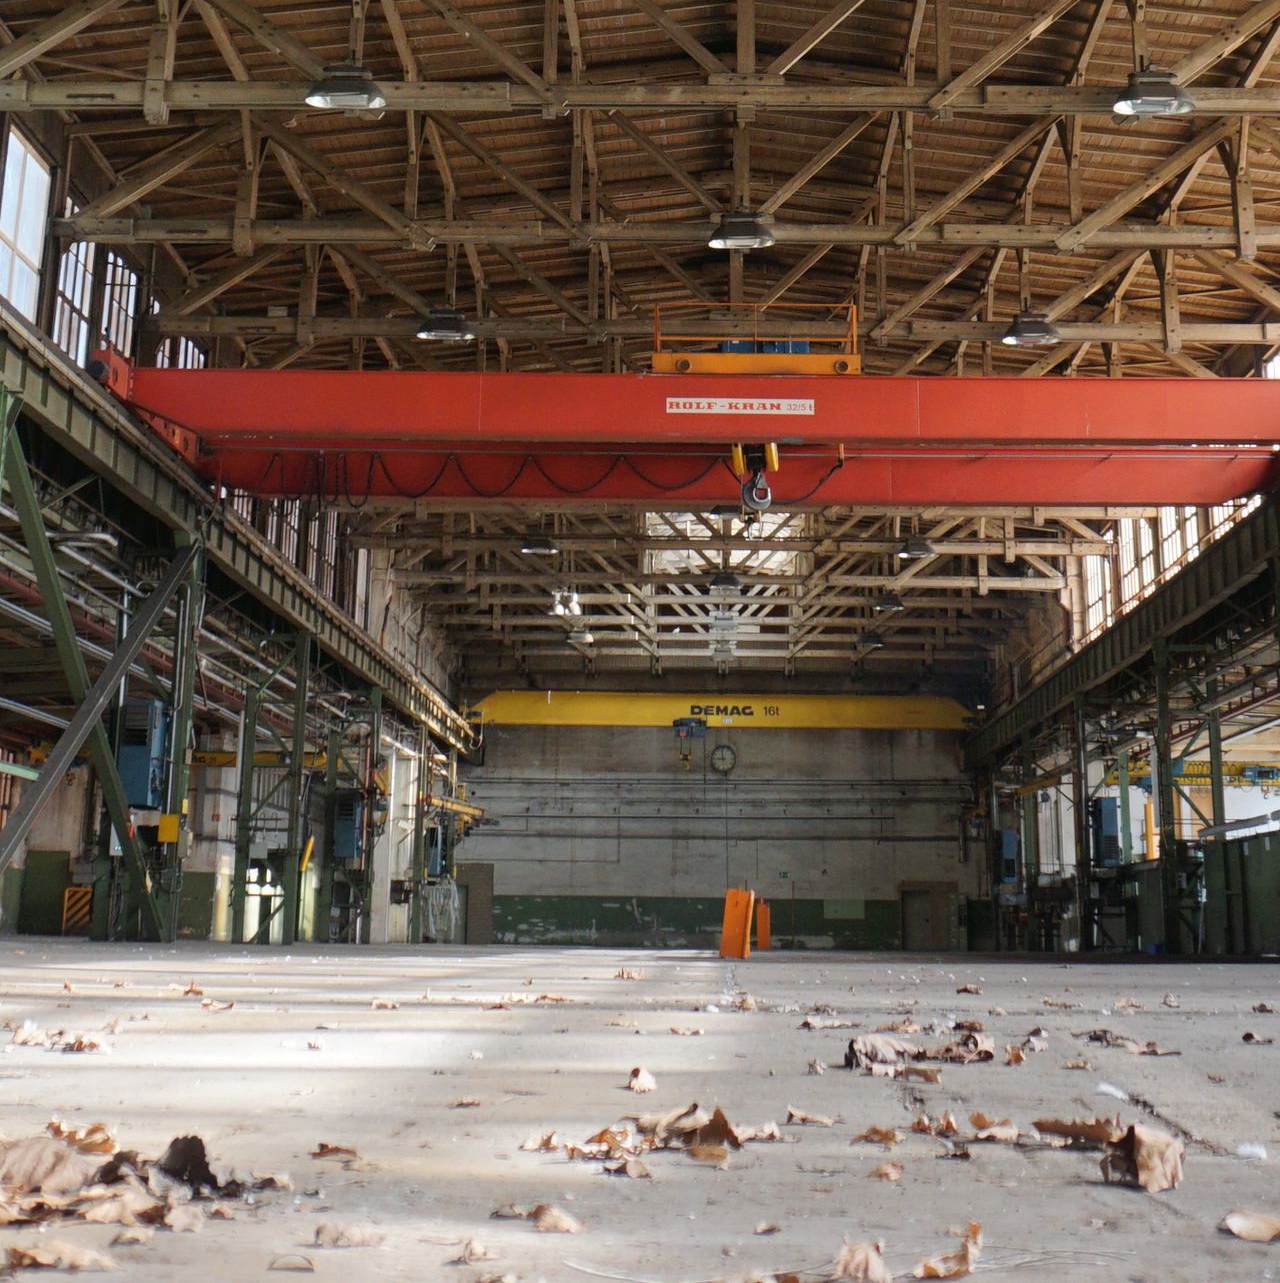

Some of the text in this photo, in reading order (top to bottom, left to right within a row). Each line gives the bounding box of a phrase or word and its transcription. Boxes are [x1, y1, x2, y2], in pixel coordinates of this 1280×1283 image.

[786, 403, 807, 411] 32/5
[690, 705, 779, 716] DEMAG 16t
